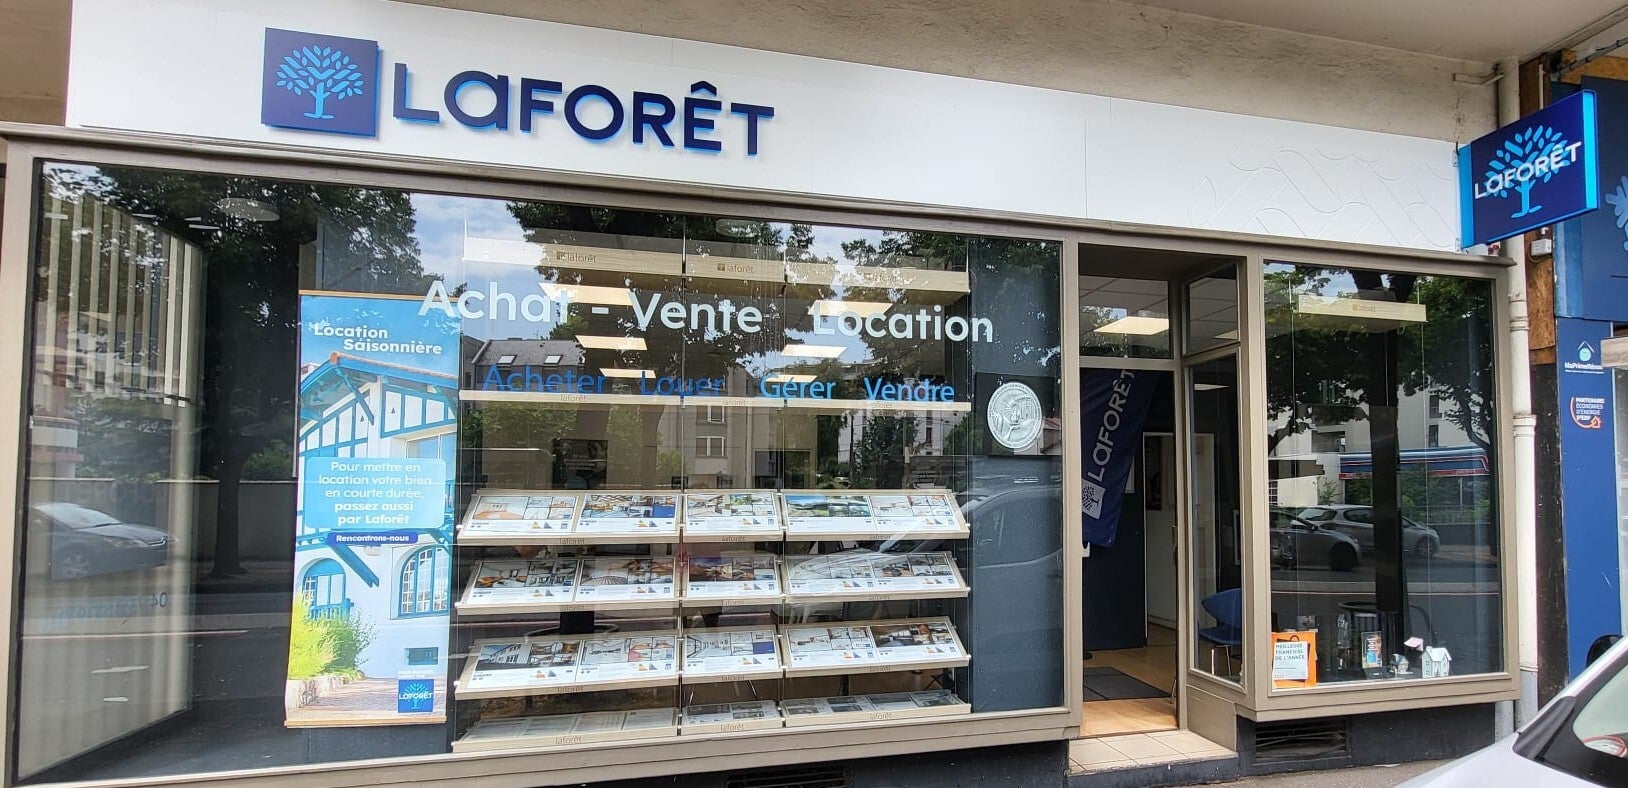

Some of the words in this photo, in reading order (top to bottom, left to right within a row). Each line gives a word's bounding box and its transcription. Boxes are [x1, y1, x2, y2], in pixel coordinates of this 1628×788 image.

[418, 279, 574, 324] Achat
[628, 291, 763, 333] Vente
[813, 300, 994, 343] Location
[314, 323, 388, 339] Location
[343, 338, 443, 355] Saisonnière
[482, 364, 607, 395] Acheter
[640, 370, 725, 397] Louer
[760, 372, 836, 400] Gérer
[863, 376, 955, 403] Vendre
[331, 461, 359, 472] Pour
[363, 462, 403, 472] mettre
[405, 464, 421, 472] en
[318, 475, 369, 485] location
[371, 476, 401, 486] votre
[405, 475, 432, 486] bien
[325, 490, 341, 498] en
[343, 489, 383, 498] courte
[387, 488, 425, 500] durée,
[334, 503, 379, 513] passez
[381, 501, 414, 511] aussi
[337, 516, 361, 526] par
[365, 514, 410, 524] Laforêt
[336, 534, 410, 543] Rencontrons-nous
